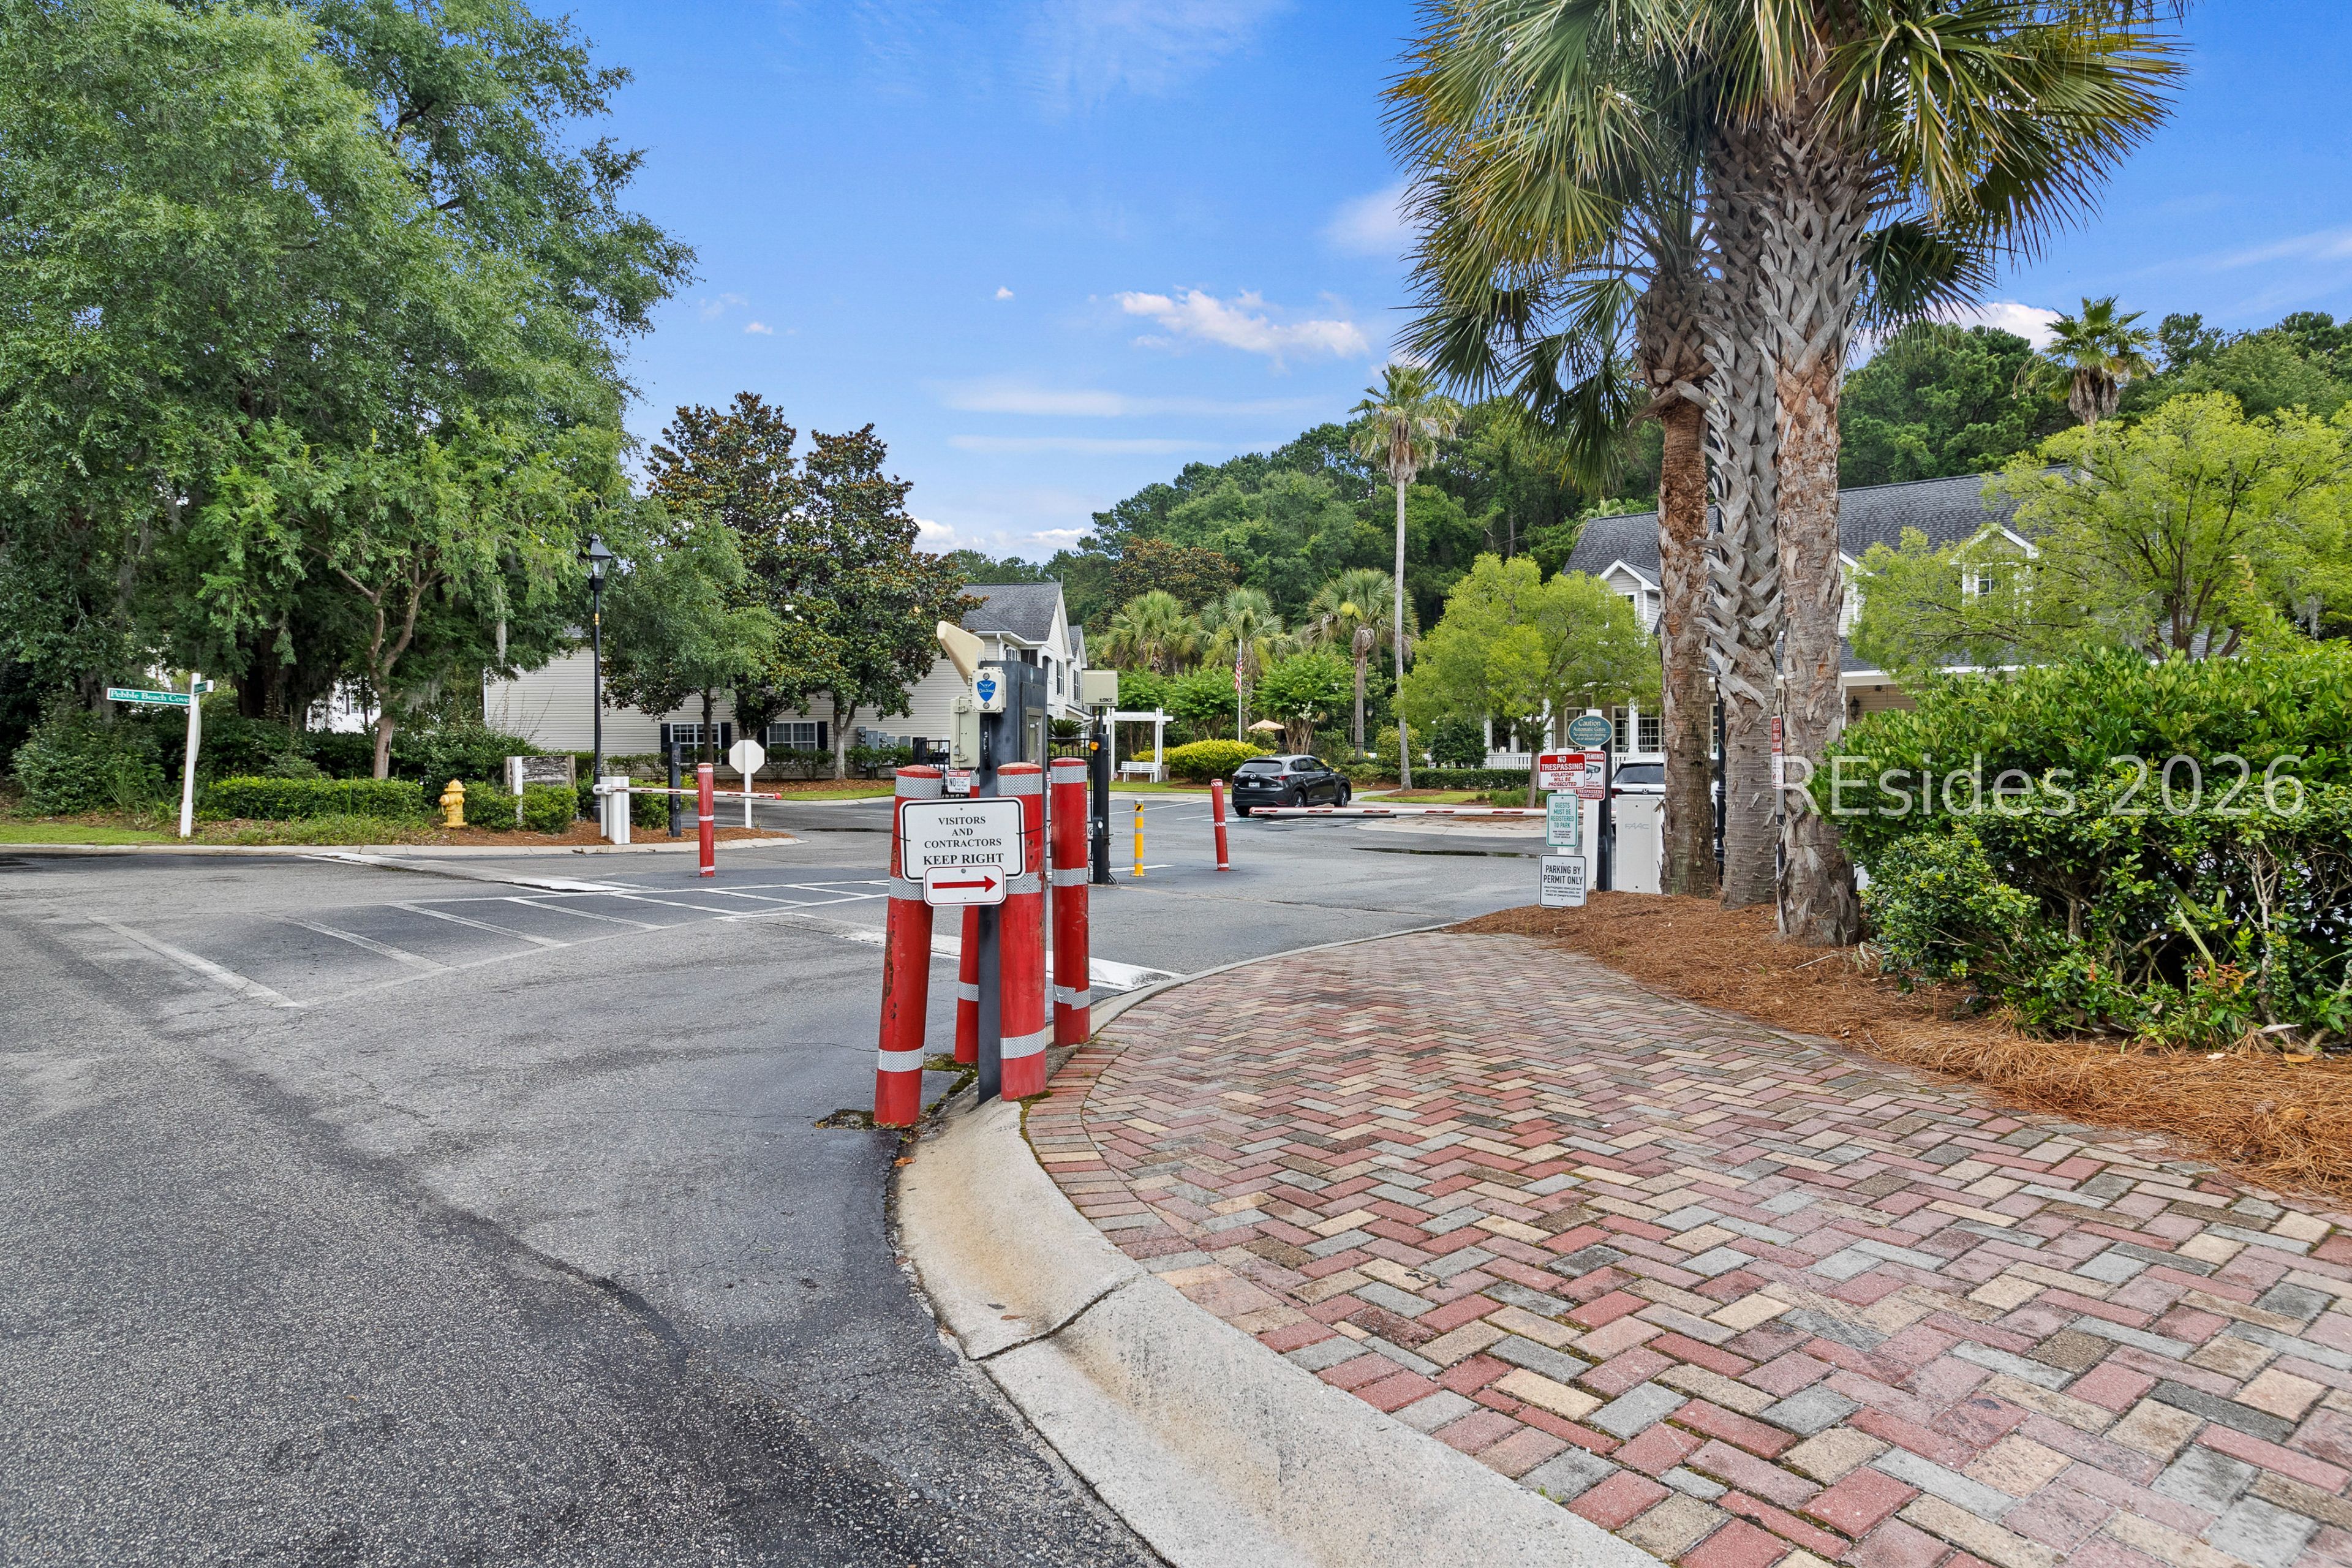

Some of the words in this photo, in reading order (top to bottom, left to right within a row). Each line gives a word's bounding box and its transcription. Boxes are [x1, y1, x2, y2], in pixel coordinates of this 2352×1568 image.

[110, 690, 139, 699] Pebble
[949, 778, 956, 786] NO
[938, 816, 986, 825] VISITORS
[924, 839, 1001, 848] CONTRACTORS
[923, 854, 957, 865] KEEP
[962, 853, 1004, 864] RIGHT
[1545, 865, 1571, 874] PARKING
[1573, 866, 1581, 875] BY
[1544, 875, 1566, 884] PERMIT
[1567, 876, 1583, 885] ONLY
